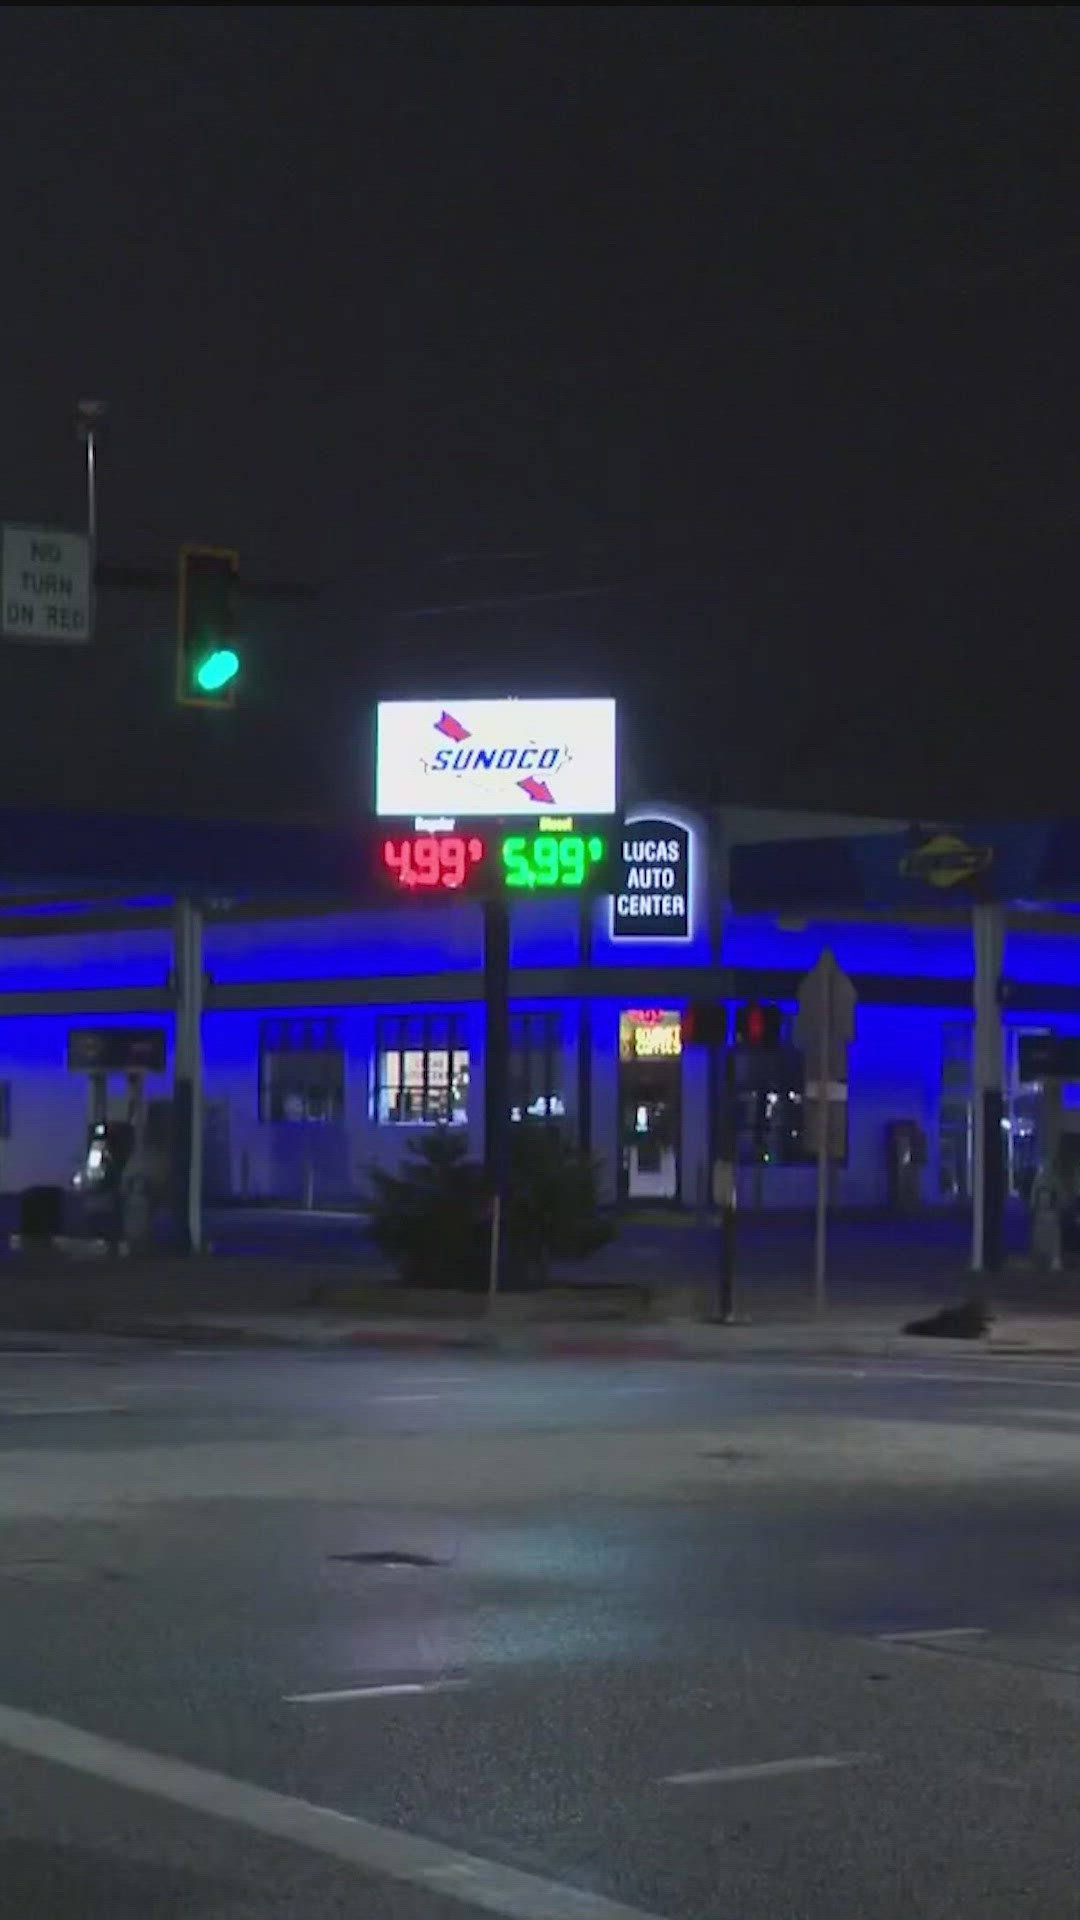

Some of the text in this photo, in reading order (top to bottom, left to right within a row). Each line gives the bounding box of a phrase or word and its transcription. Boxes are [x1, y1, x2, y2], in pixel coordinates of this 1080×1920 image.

[30, 539, 60, 562] NO
[21, 572, 73, 596] TURN
[431, 747, 561, 771] SUNOCO
[623, 840, 680, 862] LUCAS
[627, 867, 676, 889] AUTO
[617, 894, 685, 916] CENTER
